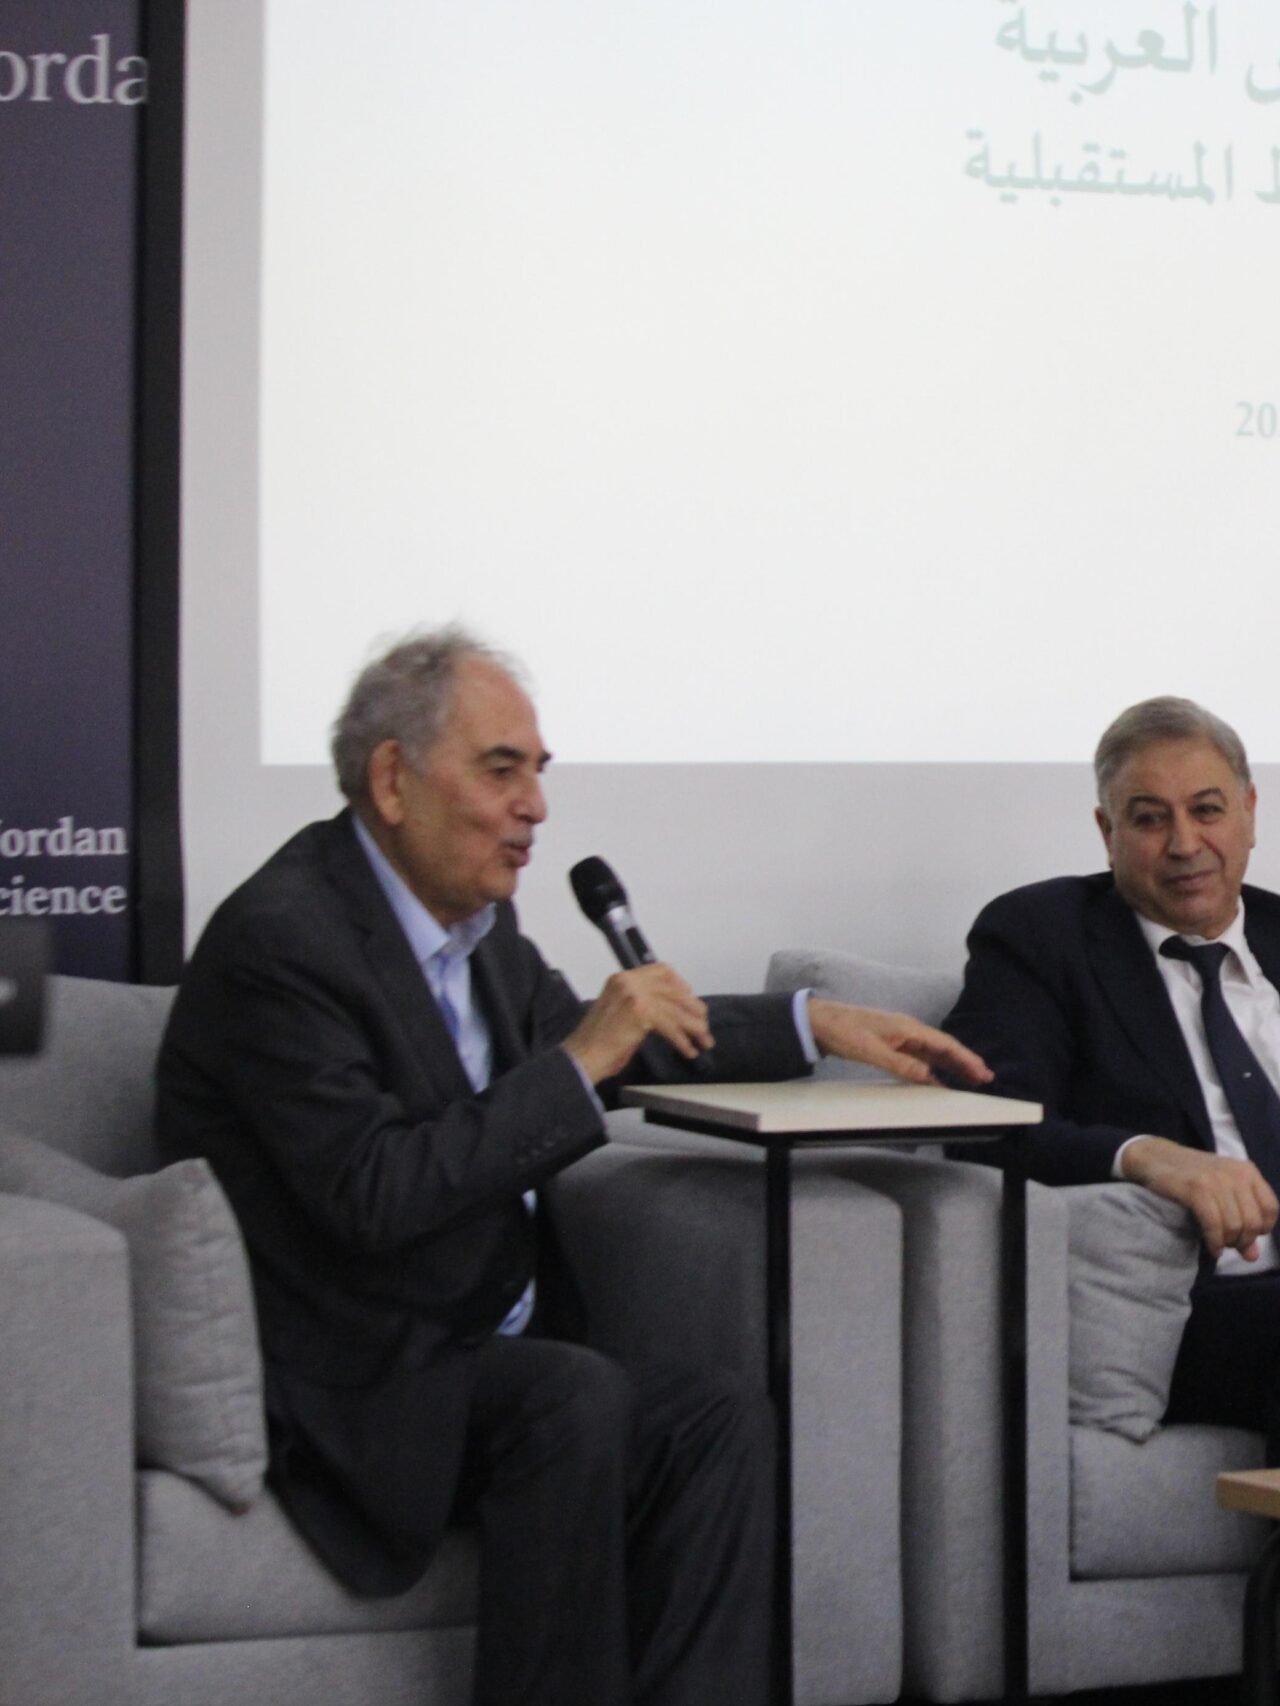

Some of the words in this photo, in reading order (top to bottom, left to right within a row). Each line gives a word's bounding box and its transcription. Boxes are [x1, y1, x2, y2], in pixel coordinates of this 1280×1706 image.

[995, 0, 1218, 105] العربية
[965, 128, 1234, 207] المستقبلية
[0, 815, 128, 857] ordan
